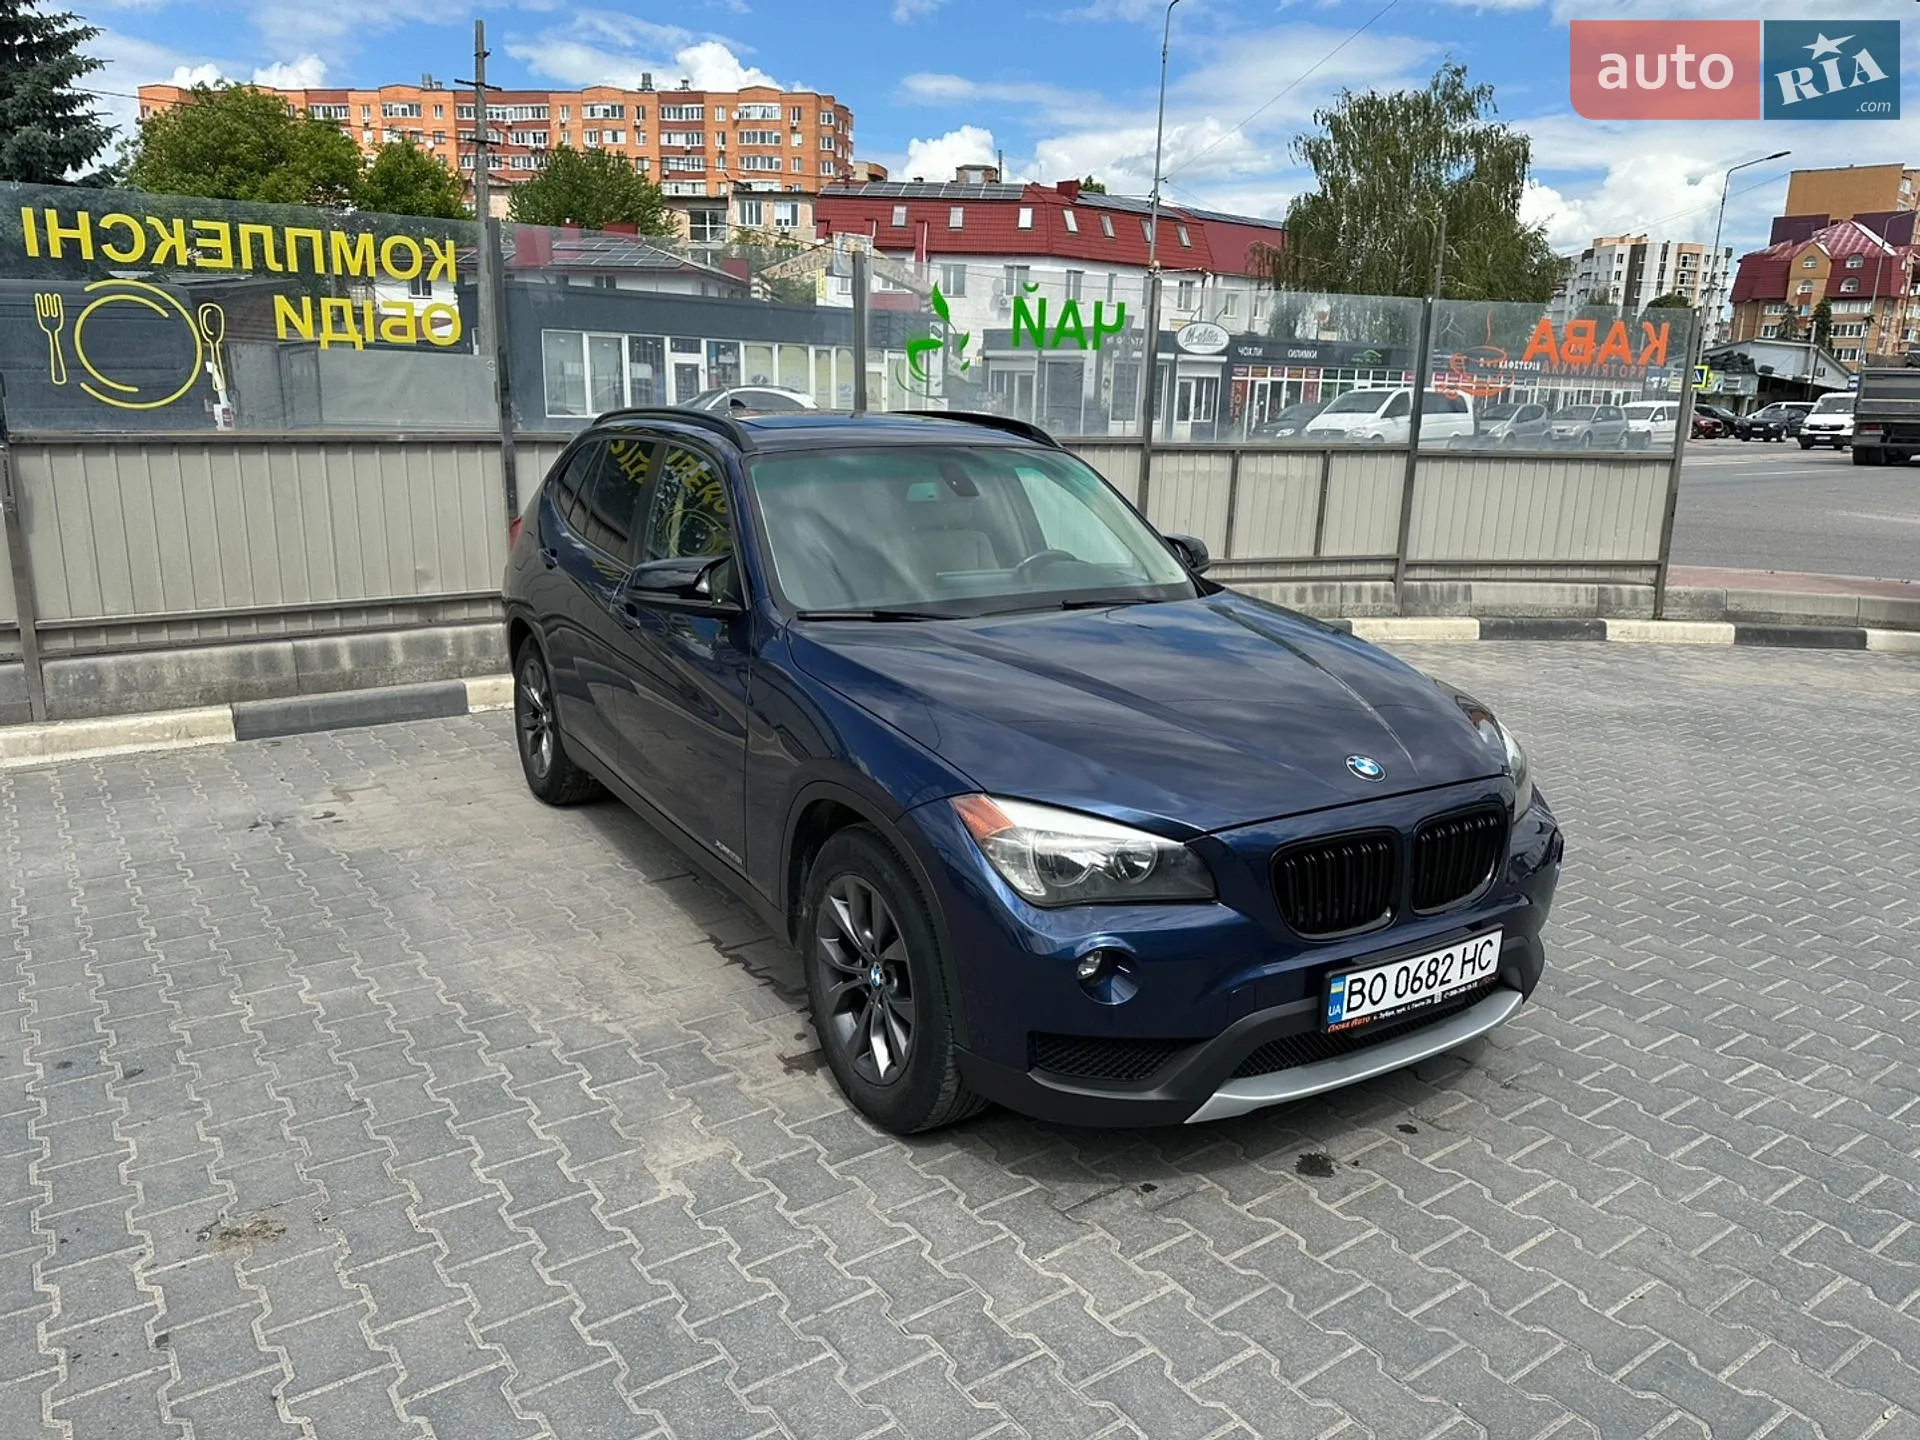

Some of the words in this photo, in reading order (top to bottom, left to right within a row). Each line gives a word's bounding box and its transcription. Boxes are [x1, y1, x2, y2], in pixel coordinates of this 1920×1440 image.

[1346, 972, 1388, 1013] BO
[1394, 952, 1454, 999] 0682
[1459, 939, 1493, 979] HC
[1327, 1006, 1341, 1016] UA
